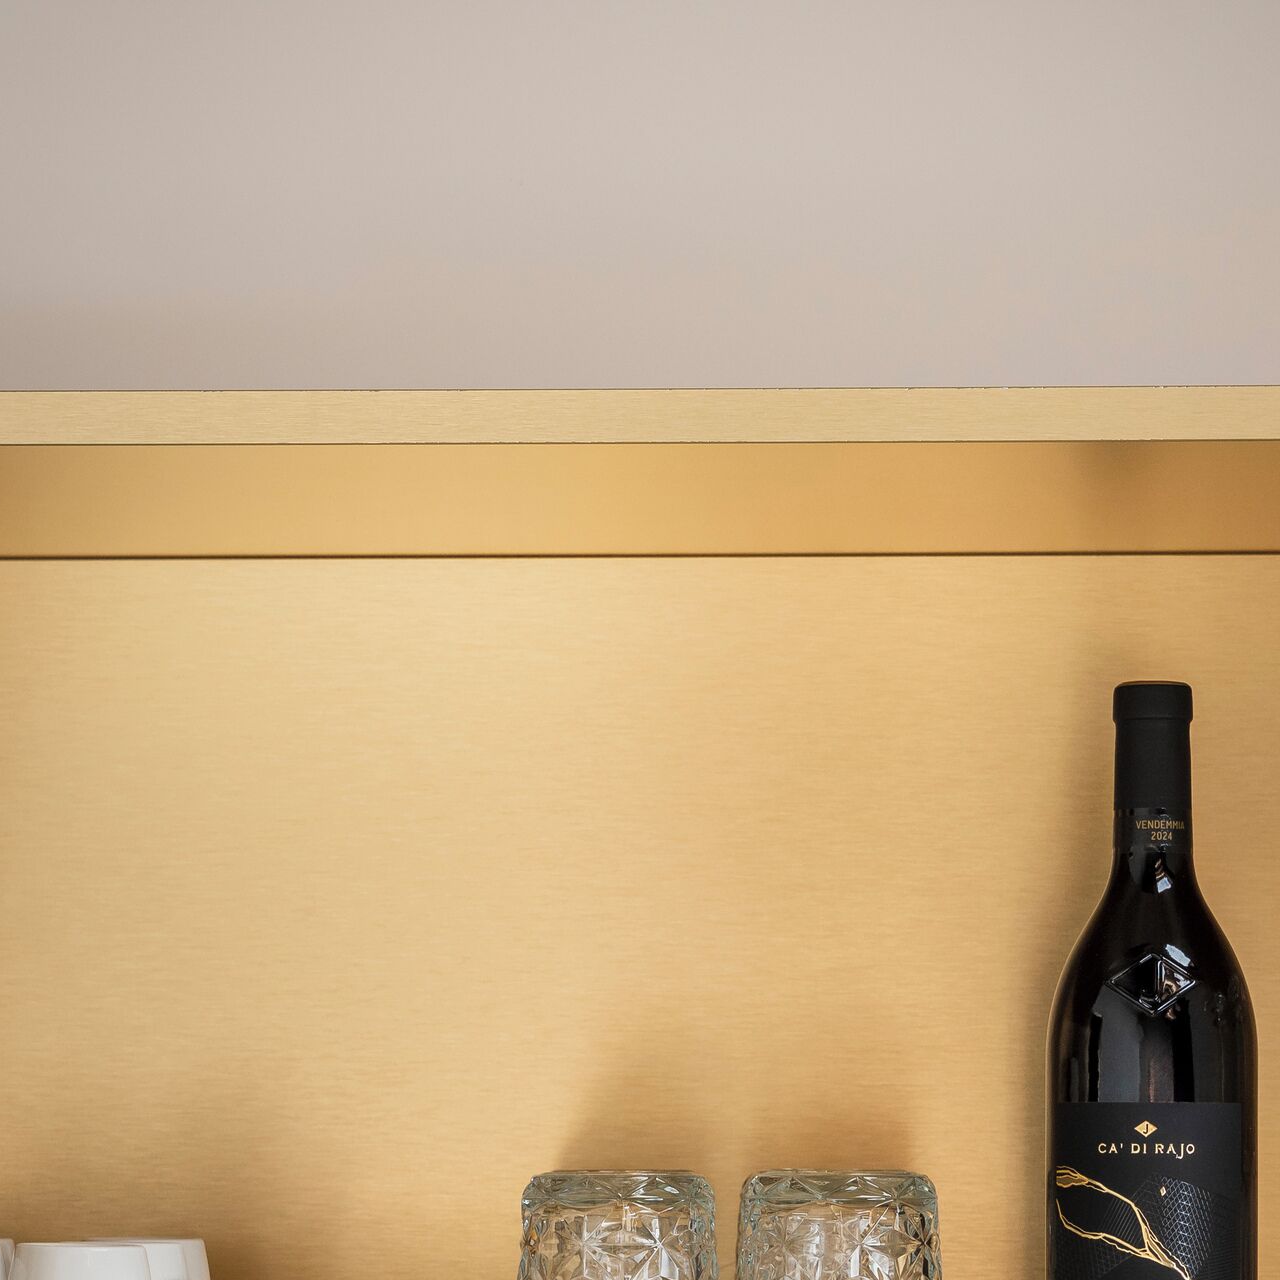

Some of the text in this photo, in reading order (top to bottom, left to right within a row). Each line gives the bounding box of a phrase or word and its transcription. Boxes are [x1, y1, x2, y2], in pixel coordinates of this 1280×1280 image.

[1135, 819, 1185, 830] VENDEMMIA
[1151, 831, 1173, 841] 2024
[1098, 1143, 1195, 1159] CA' DI RAJO
